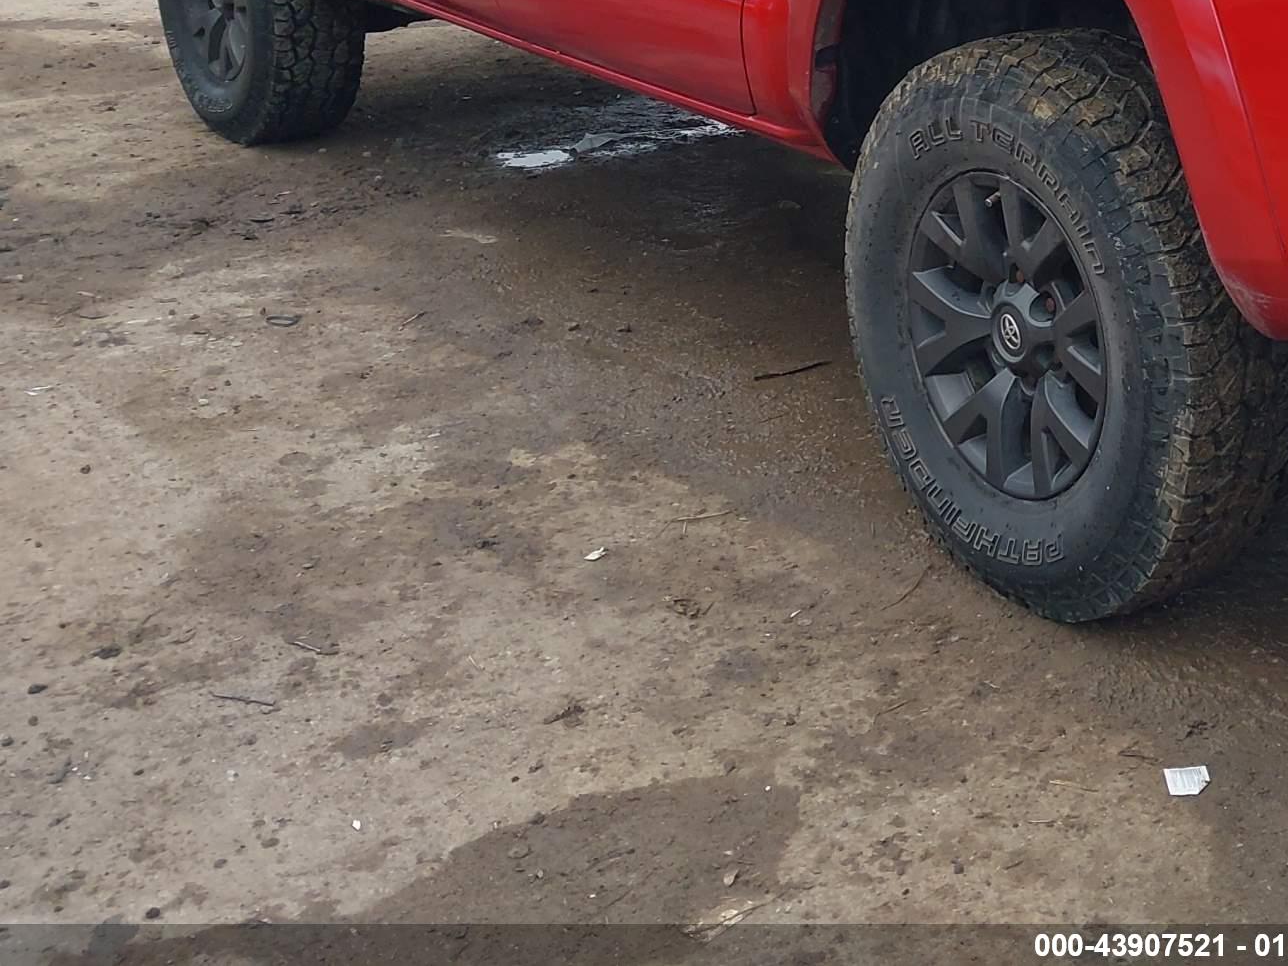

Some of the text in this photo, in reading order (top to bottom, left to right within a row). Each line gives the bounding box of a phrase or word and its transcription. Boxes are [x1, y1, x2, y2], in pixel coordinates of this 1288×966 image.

[908, 116, 1106, 276] ALL TERRAIN
[879, 394, 1065, 566] PATHFINDER
